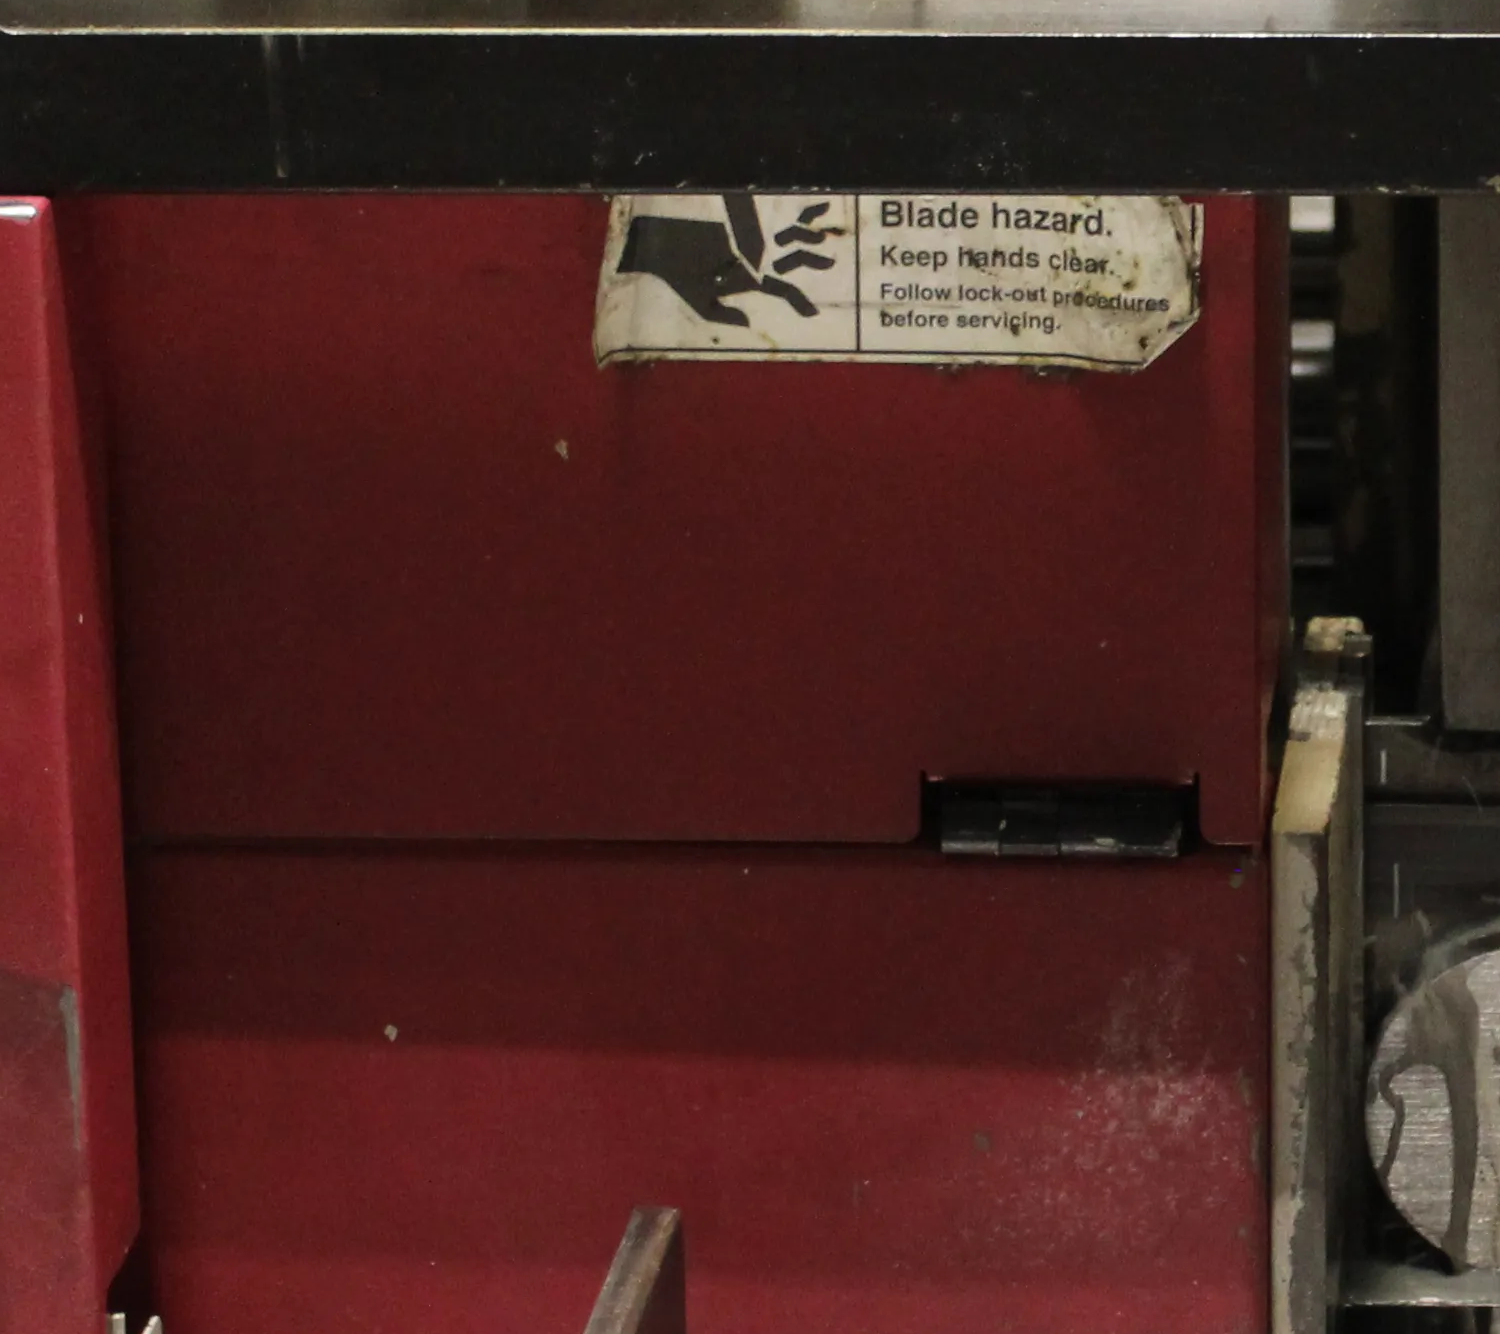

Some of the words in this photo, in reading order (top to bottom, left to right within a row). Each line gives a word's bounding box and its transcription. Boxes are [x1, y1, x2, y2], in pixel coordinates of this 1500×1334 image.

[880, 201, 979, 229] Blade
[991, 202, 1113, 237] hazard.
[880, 245, 948, 271] Keep
[958, 246, 1041, 269] hands
[1048, 249, 1115, 275] clear.
[880, 283, 951, 301] Follow
[958, 284, 1047, 303] lock-out
[1052, 290, 1171, 312] procedures
[880, 311, 949, 329] before
[956, 311, 1062, 335] servicing.
